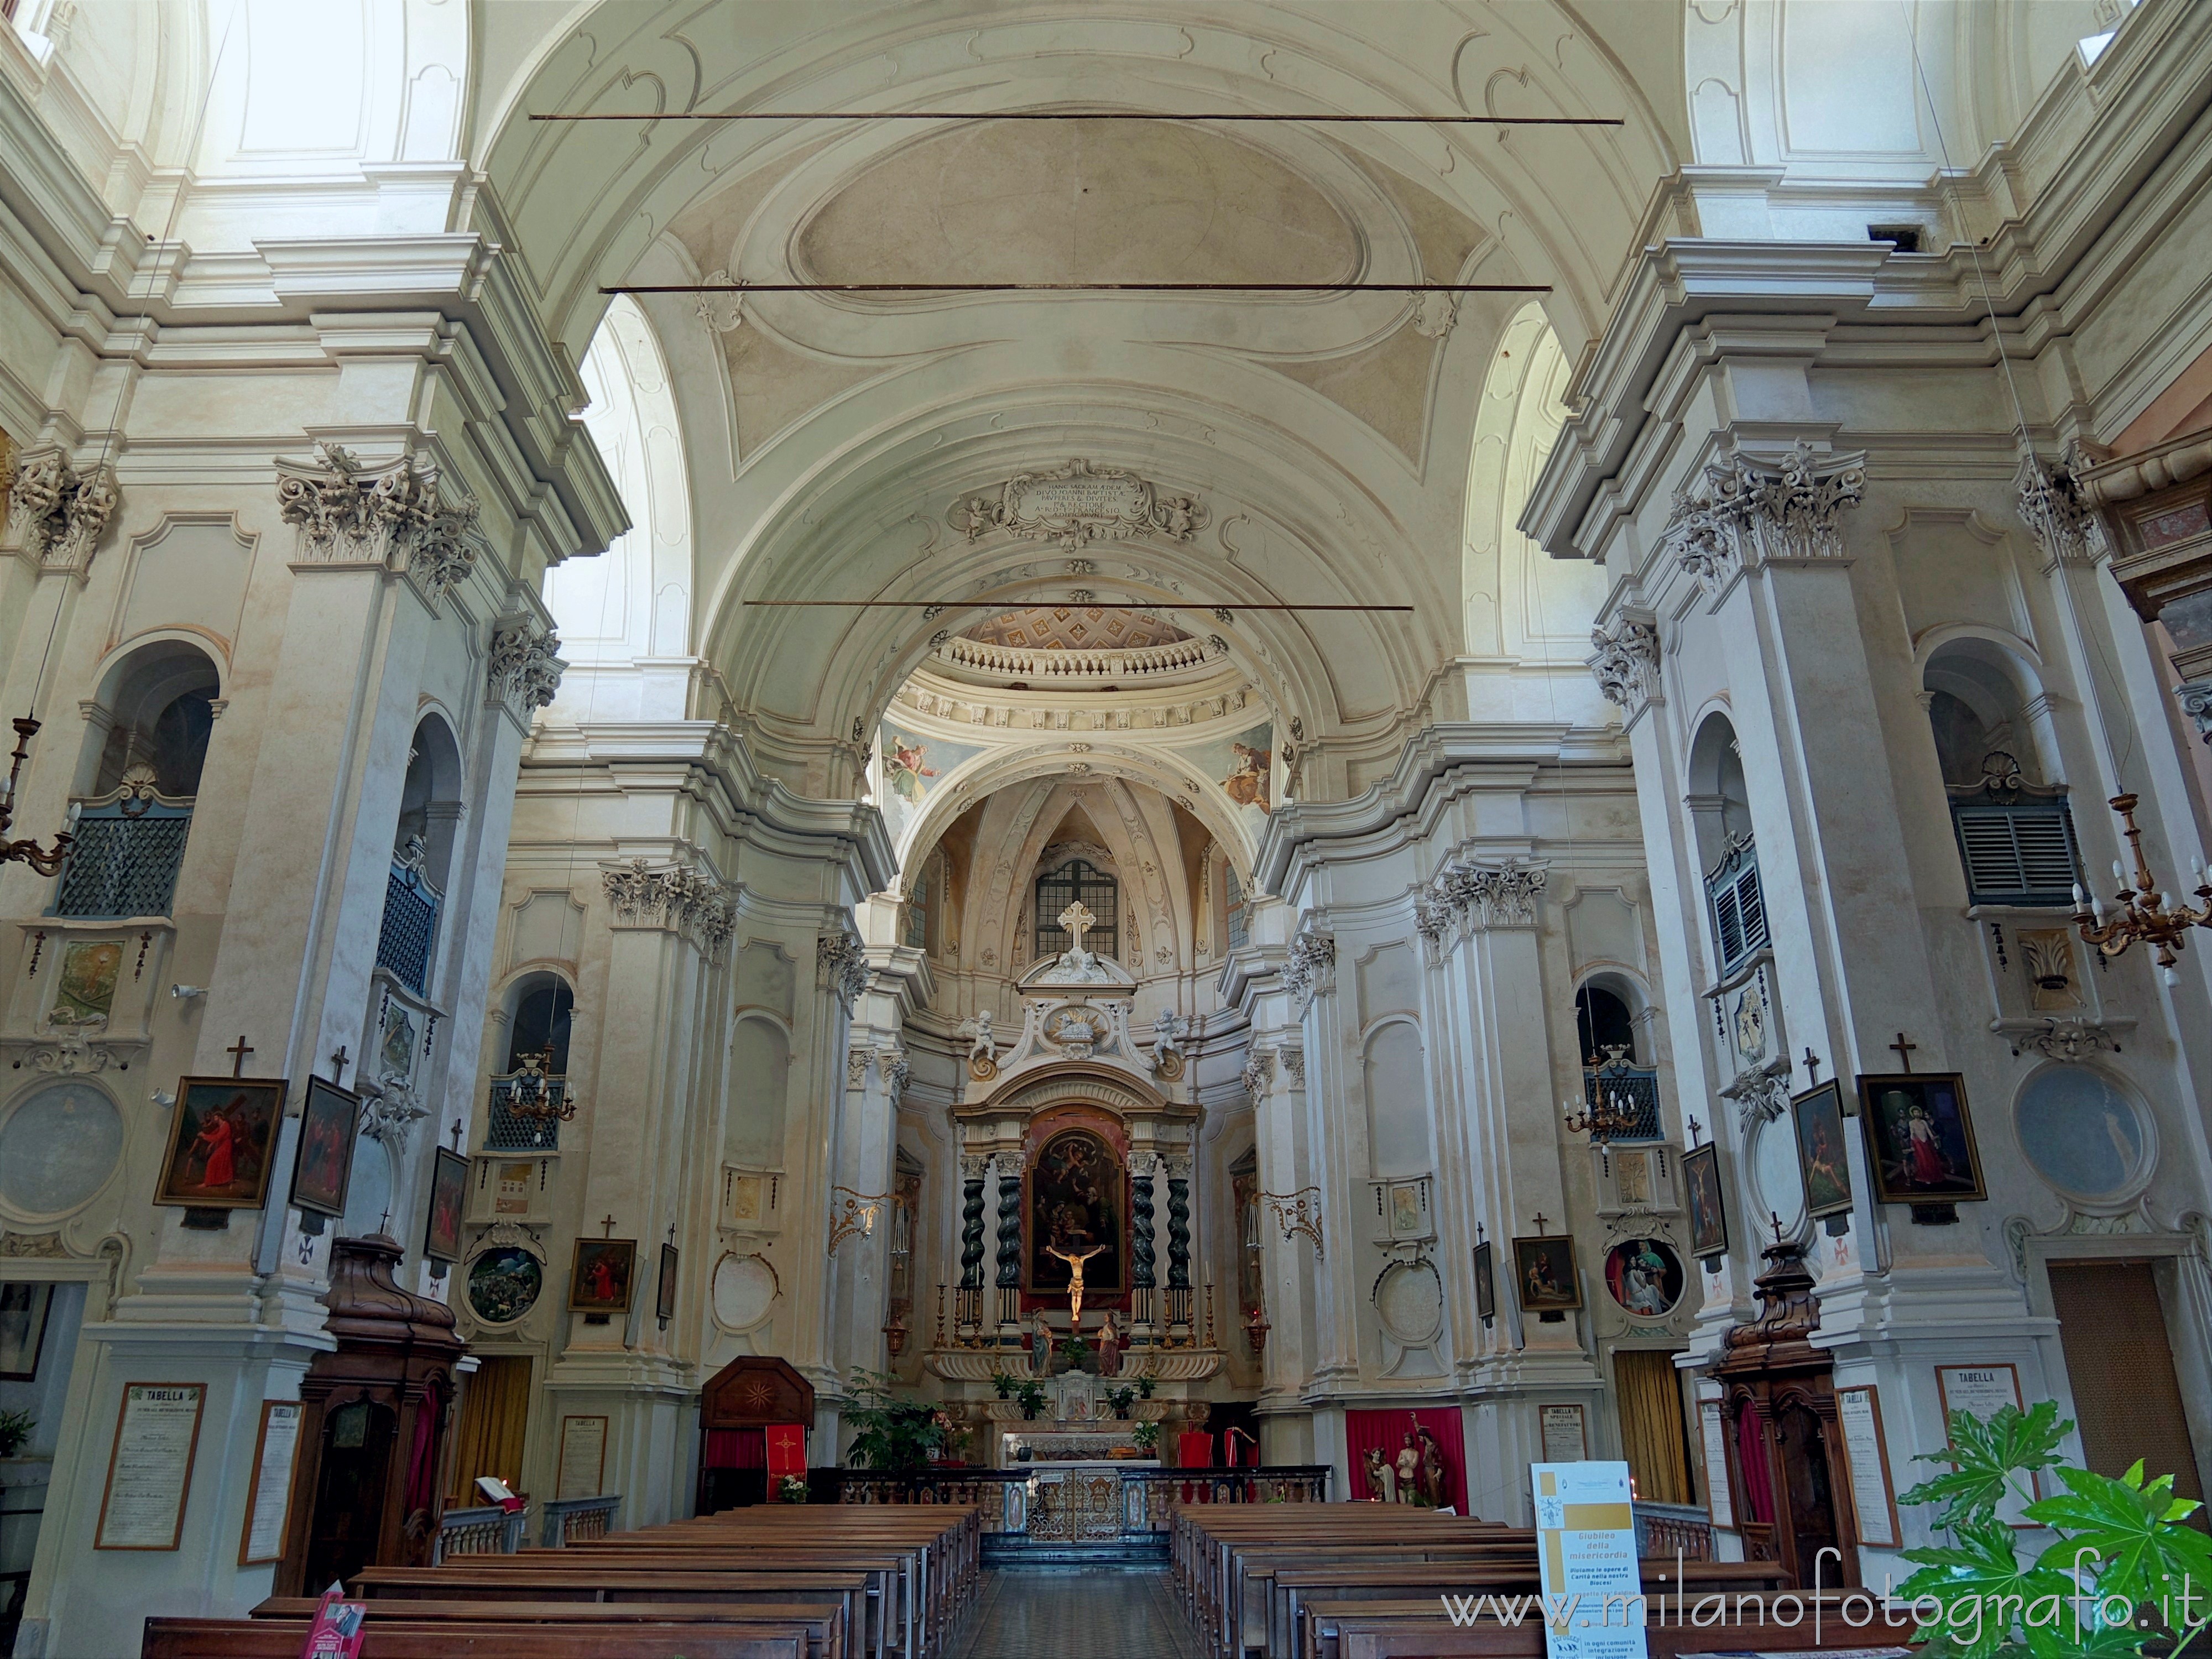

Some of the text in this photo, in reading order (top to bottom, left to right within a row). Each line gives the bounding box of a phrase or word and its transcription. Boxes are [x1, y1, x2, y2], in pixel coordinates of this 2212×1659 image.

[1958, 1372, 1995, 1383] TABELLA
[147, 1391, 183, 1401] TABELLA
[1578, 1532, 1615, 1540] Giubileo
[1569, 1551, 1627, 1560] misericordia
